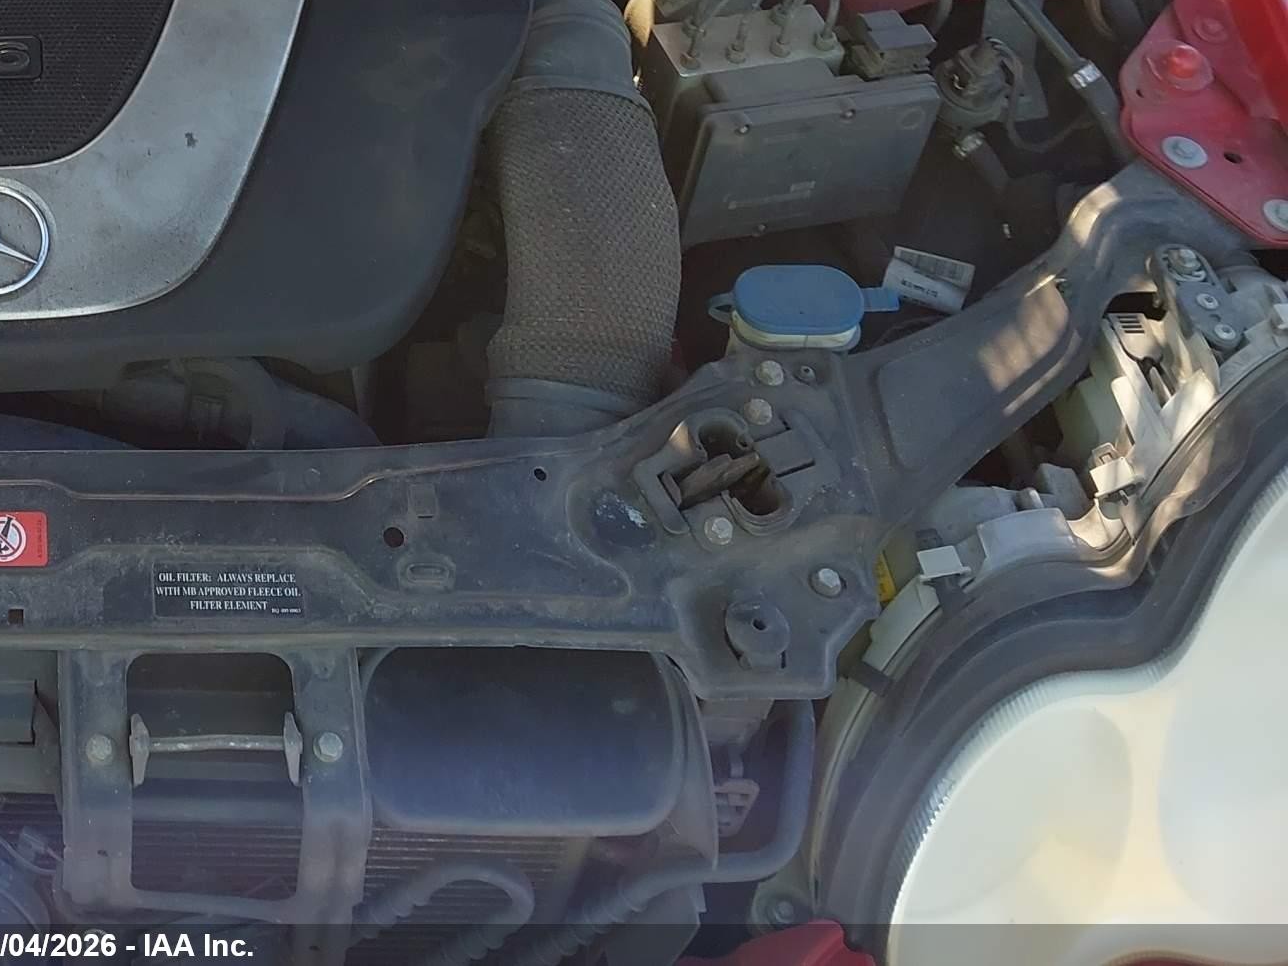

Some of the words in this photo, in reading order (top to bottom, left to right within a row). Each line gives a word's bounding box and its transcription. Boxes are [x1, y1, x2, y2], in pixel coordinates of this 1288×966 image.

[158, 573, 175, 582] OIL
[176, 573, 212, 582] FILTER:
[217, 573, 253, 583] ALWAYS
[254, 573, 296, 583] REPLACE
[155, 586, 180, 596] WITH
[182, 587, 197, 596] MB
[198, 587, 246, 596] APPROVED
[247, 587, 283, 597] FLEECE
[284, 587, 301, 597] OIL
[190, 600, 222, 610] FILTER
[224, 601, 268, 611] ELEMENT
